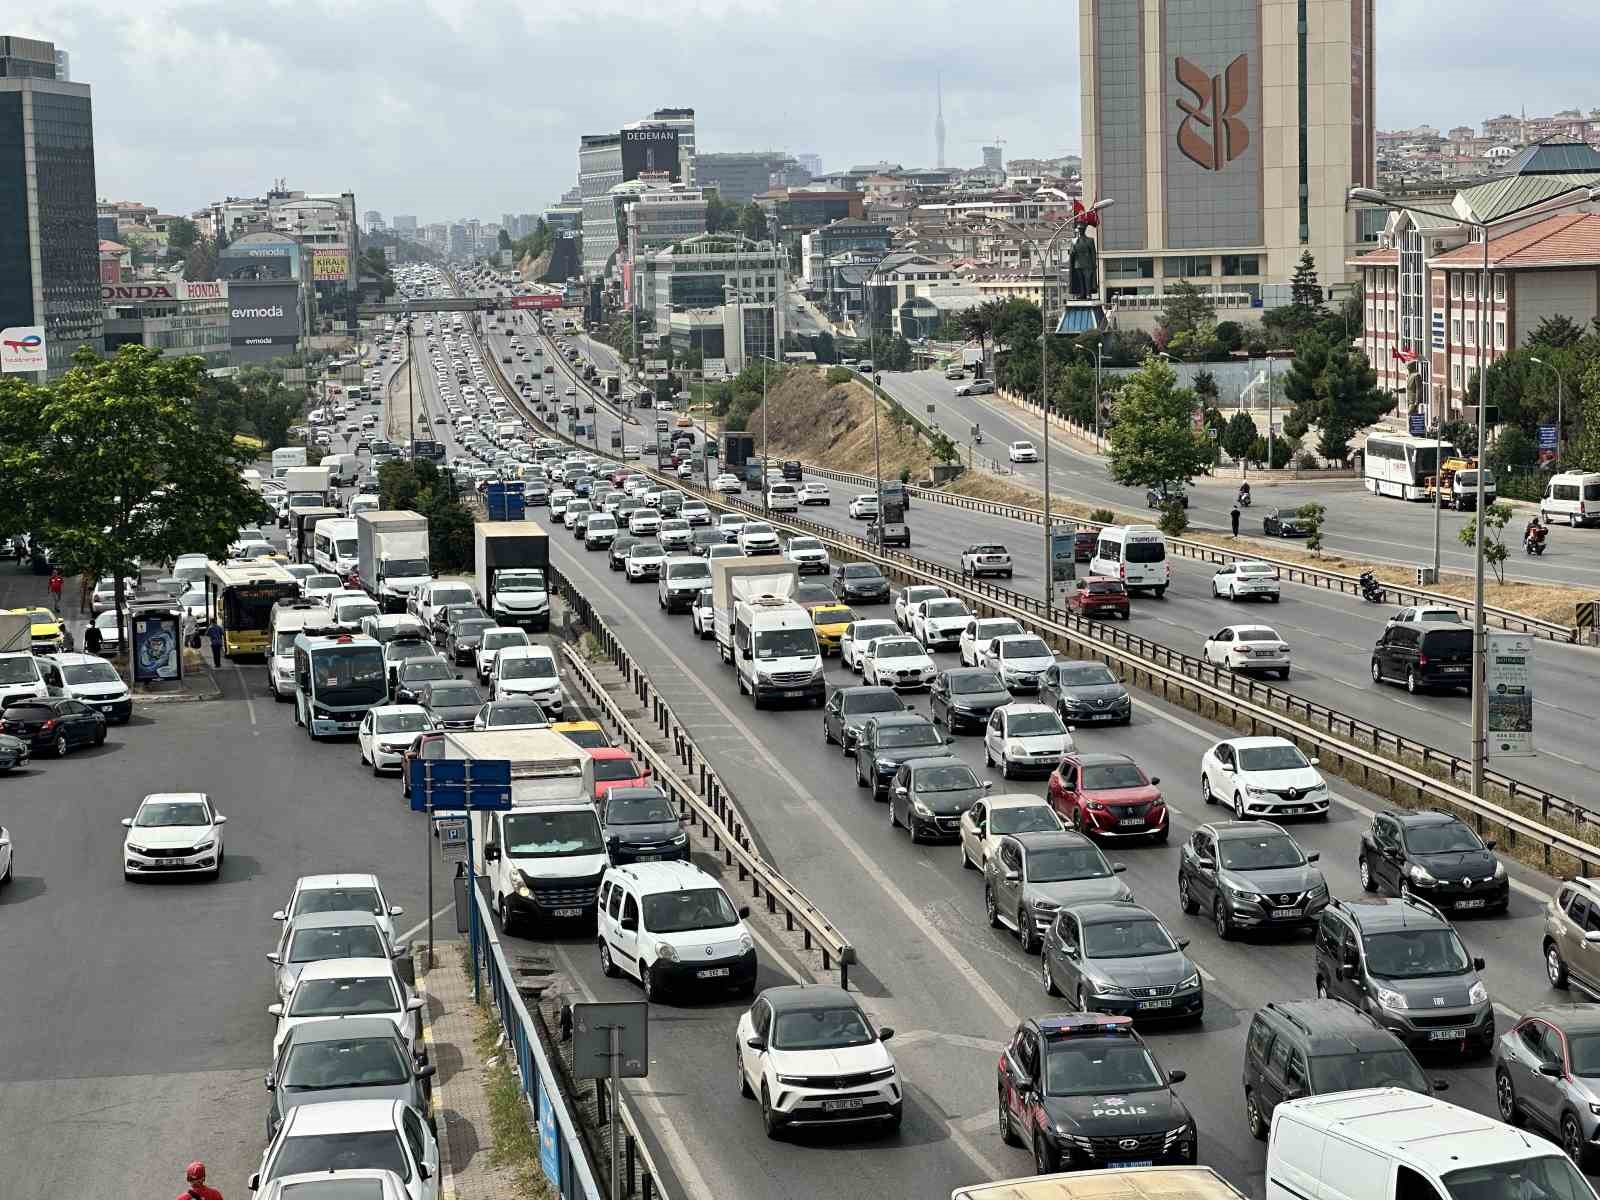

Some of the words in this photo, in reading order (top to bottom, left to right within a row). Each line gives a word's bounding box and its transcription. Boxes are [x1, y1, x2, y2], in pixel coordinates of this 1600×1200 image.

[626, 131, 674, 141] DEDEMAN
[101, 286, 171, 298] ONDA
[187, 283, 221, 297] HONDA
[231, 305, 283, 318] evmoda
[245, 337, 272, 345] evmoda
